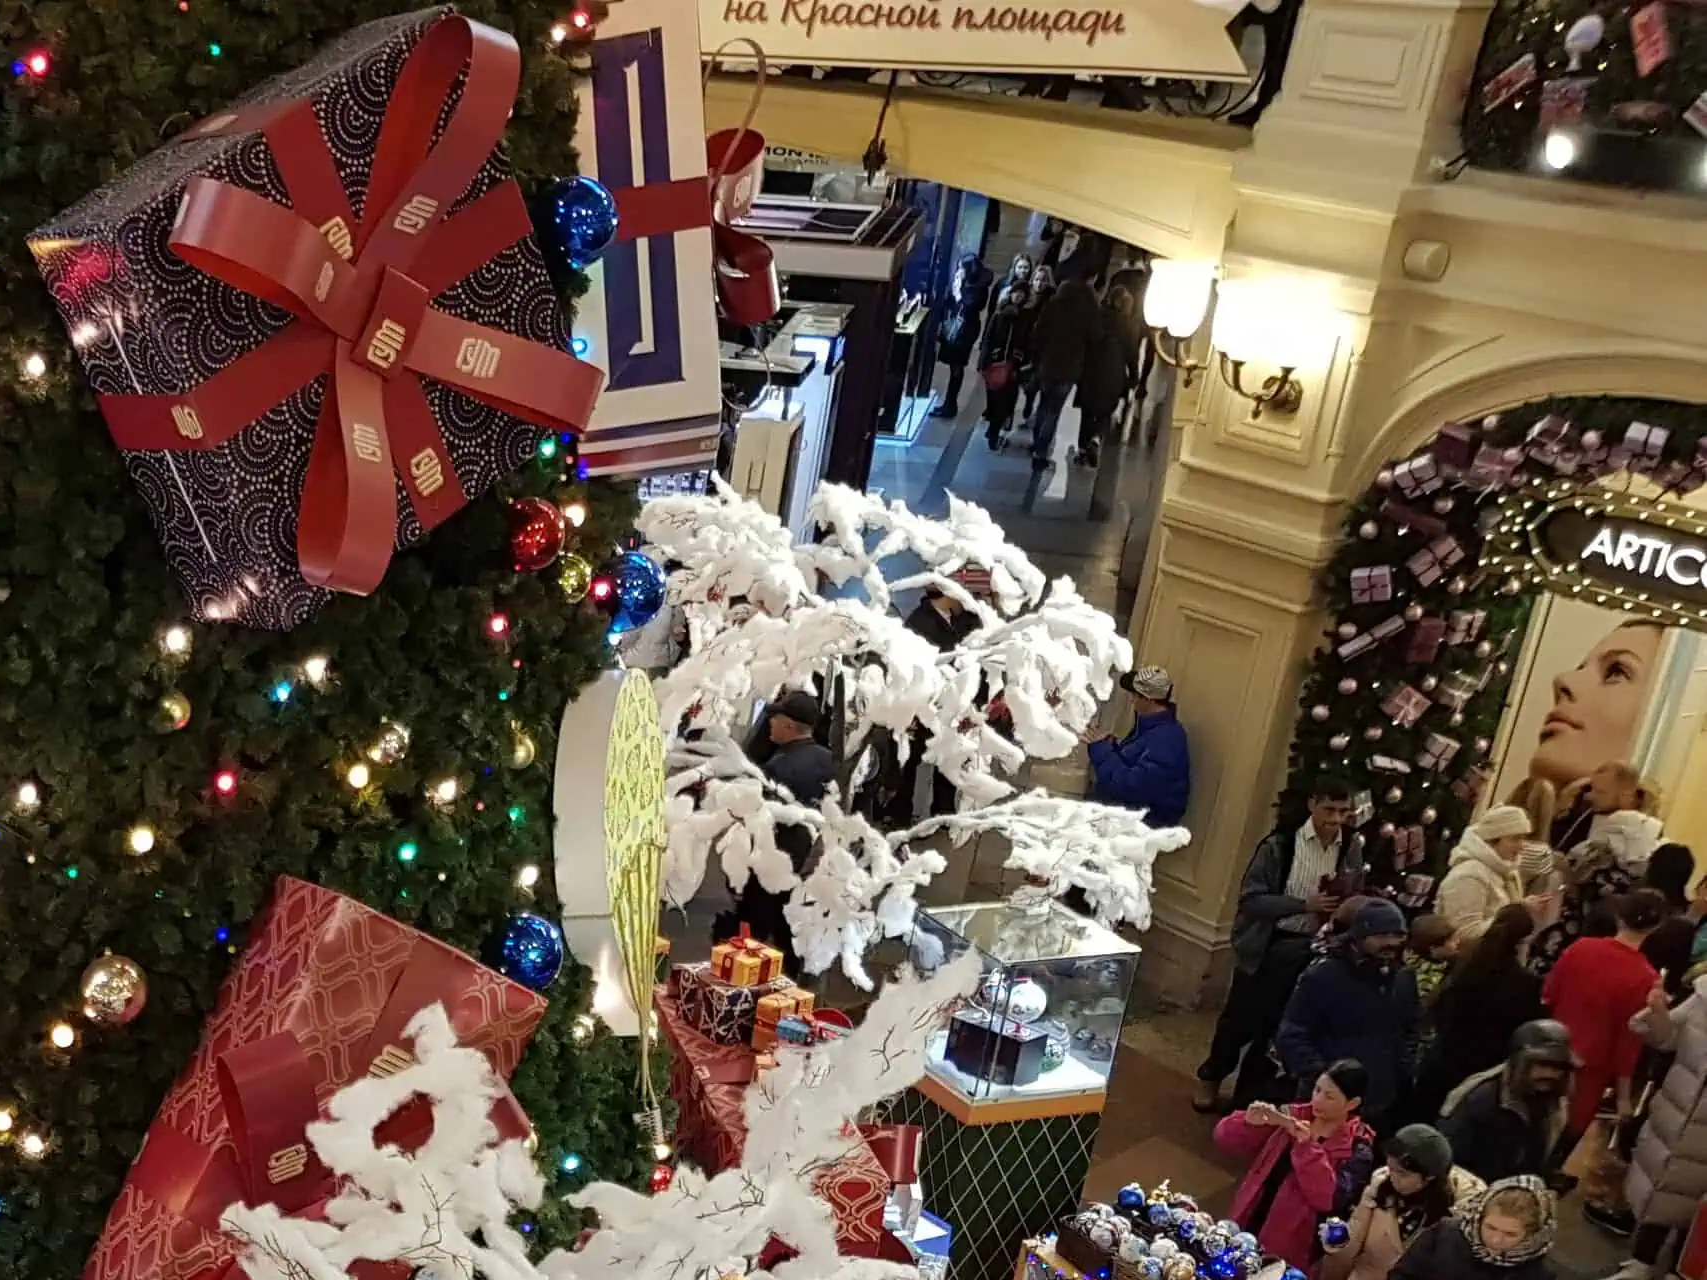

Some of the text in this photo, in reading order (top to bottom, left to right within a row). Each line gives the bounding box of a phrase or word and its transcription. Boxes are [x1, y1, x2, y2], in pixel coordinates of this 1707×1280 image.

[722, 0, 1126, 47] на Красной площади
[1580, 526, 1707, 590] ARTIC
